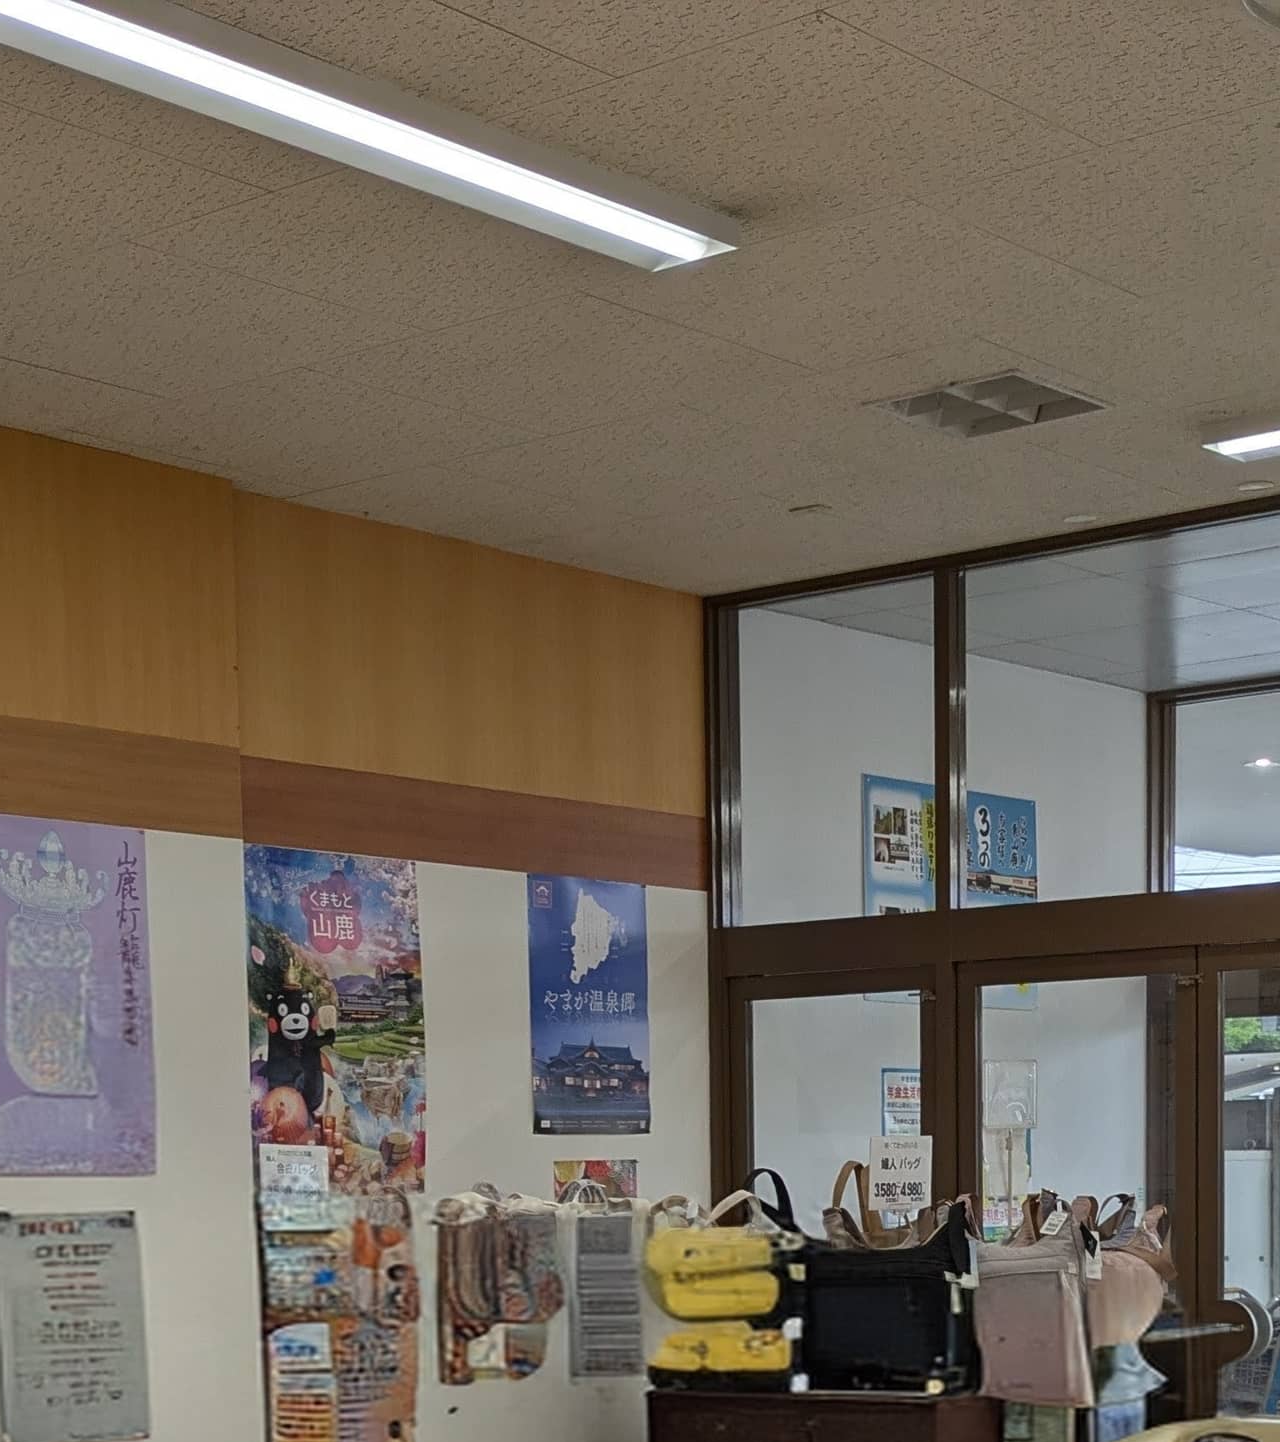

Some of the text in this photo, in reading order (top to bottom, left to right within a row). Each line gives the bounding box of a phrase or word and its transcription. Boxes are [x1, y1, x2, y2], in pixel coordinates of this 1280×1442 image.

[310, 890, 353, 909] くまもと
[312, 914, 355, 941] 山鹿
[544, 989, 636, 1014] やまが温泉郷
[900, 1156, 922, 1170] バッグ
